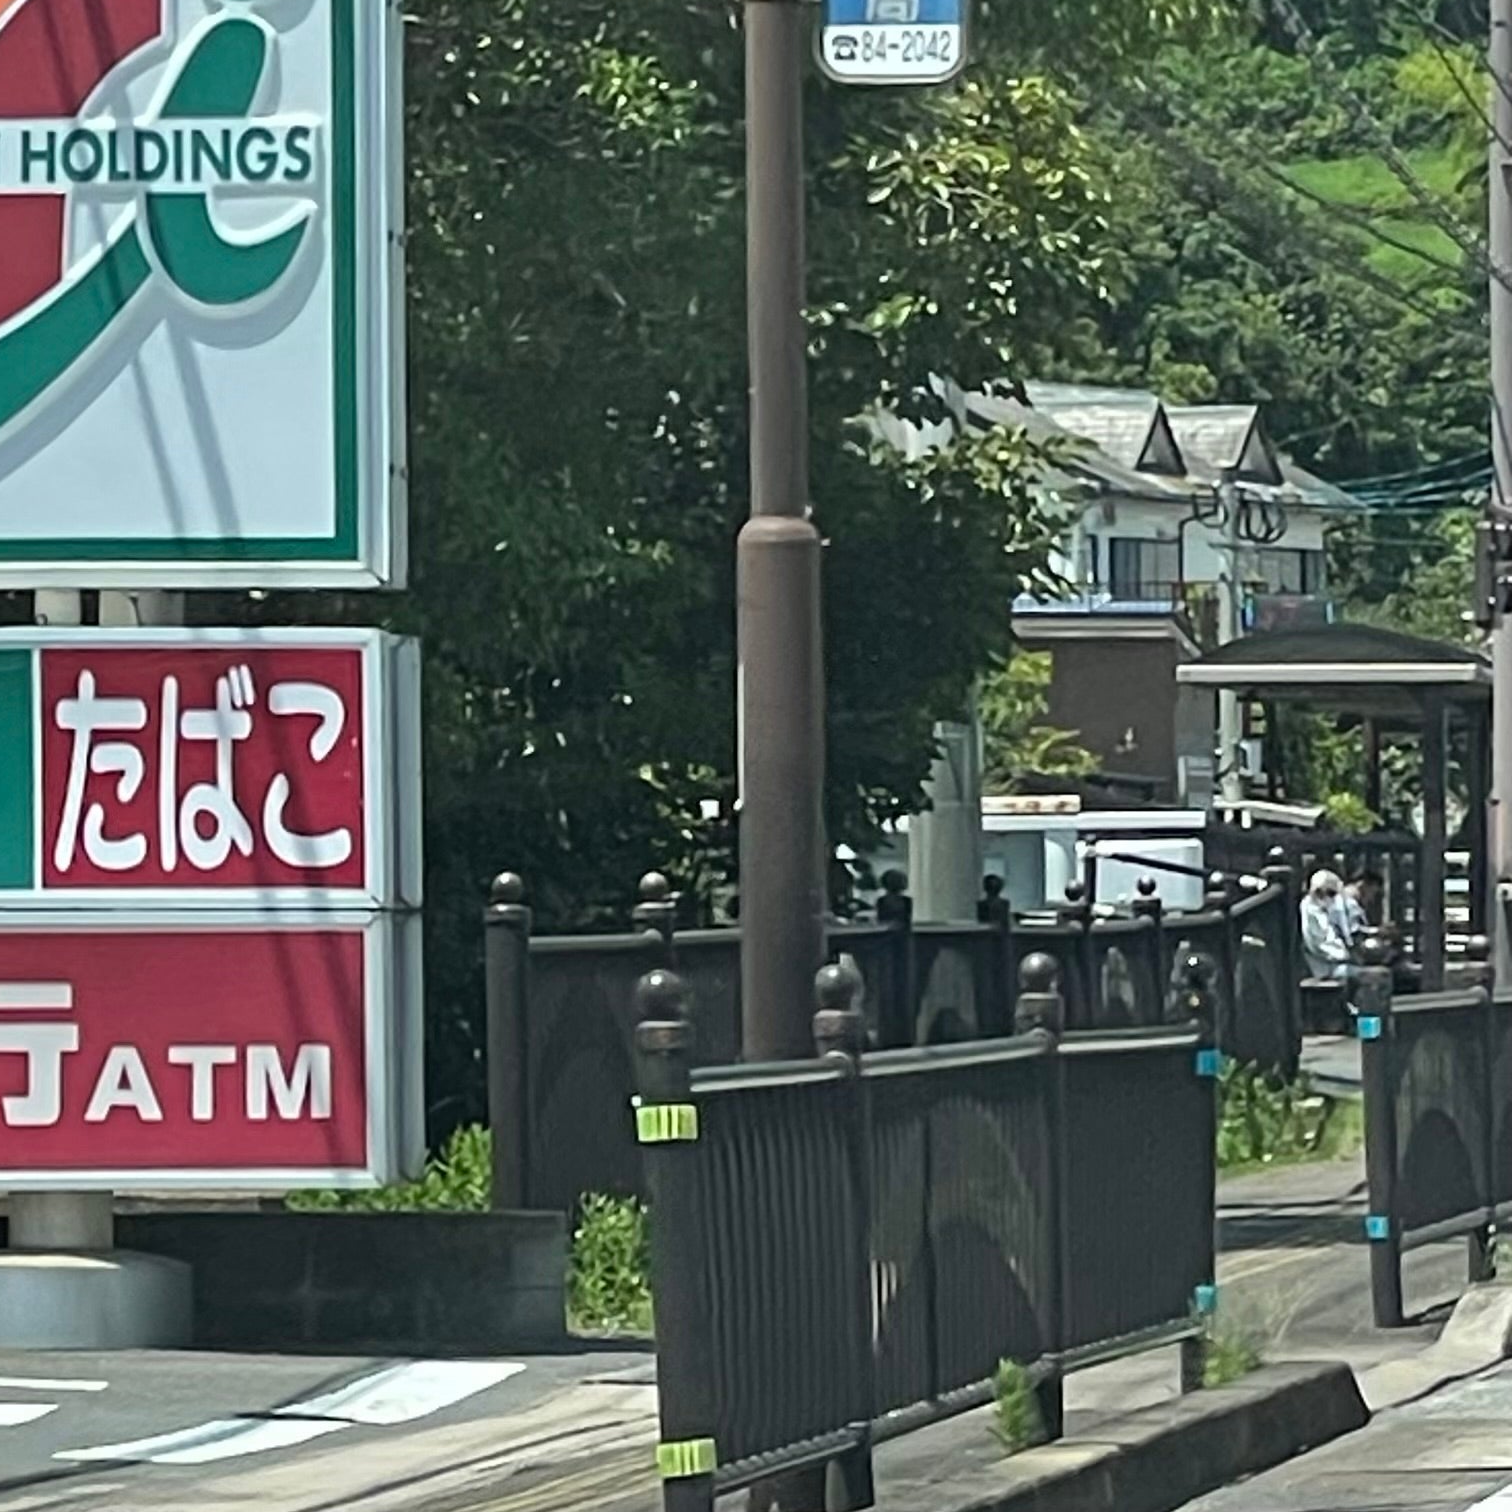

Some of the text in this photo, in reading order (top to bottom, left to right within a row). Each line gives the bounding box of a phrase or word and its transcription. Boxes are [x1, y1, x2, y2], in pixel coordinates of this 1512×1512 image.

[862, 30, 952, 62] 84-2042
[21, 127, 312, 183] HOLDINGS
[54, 666, 351, 872] たばこ
